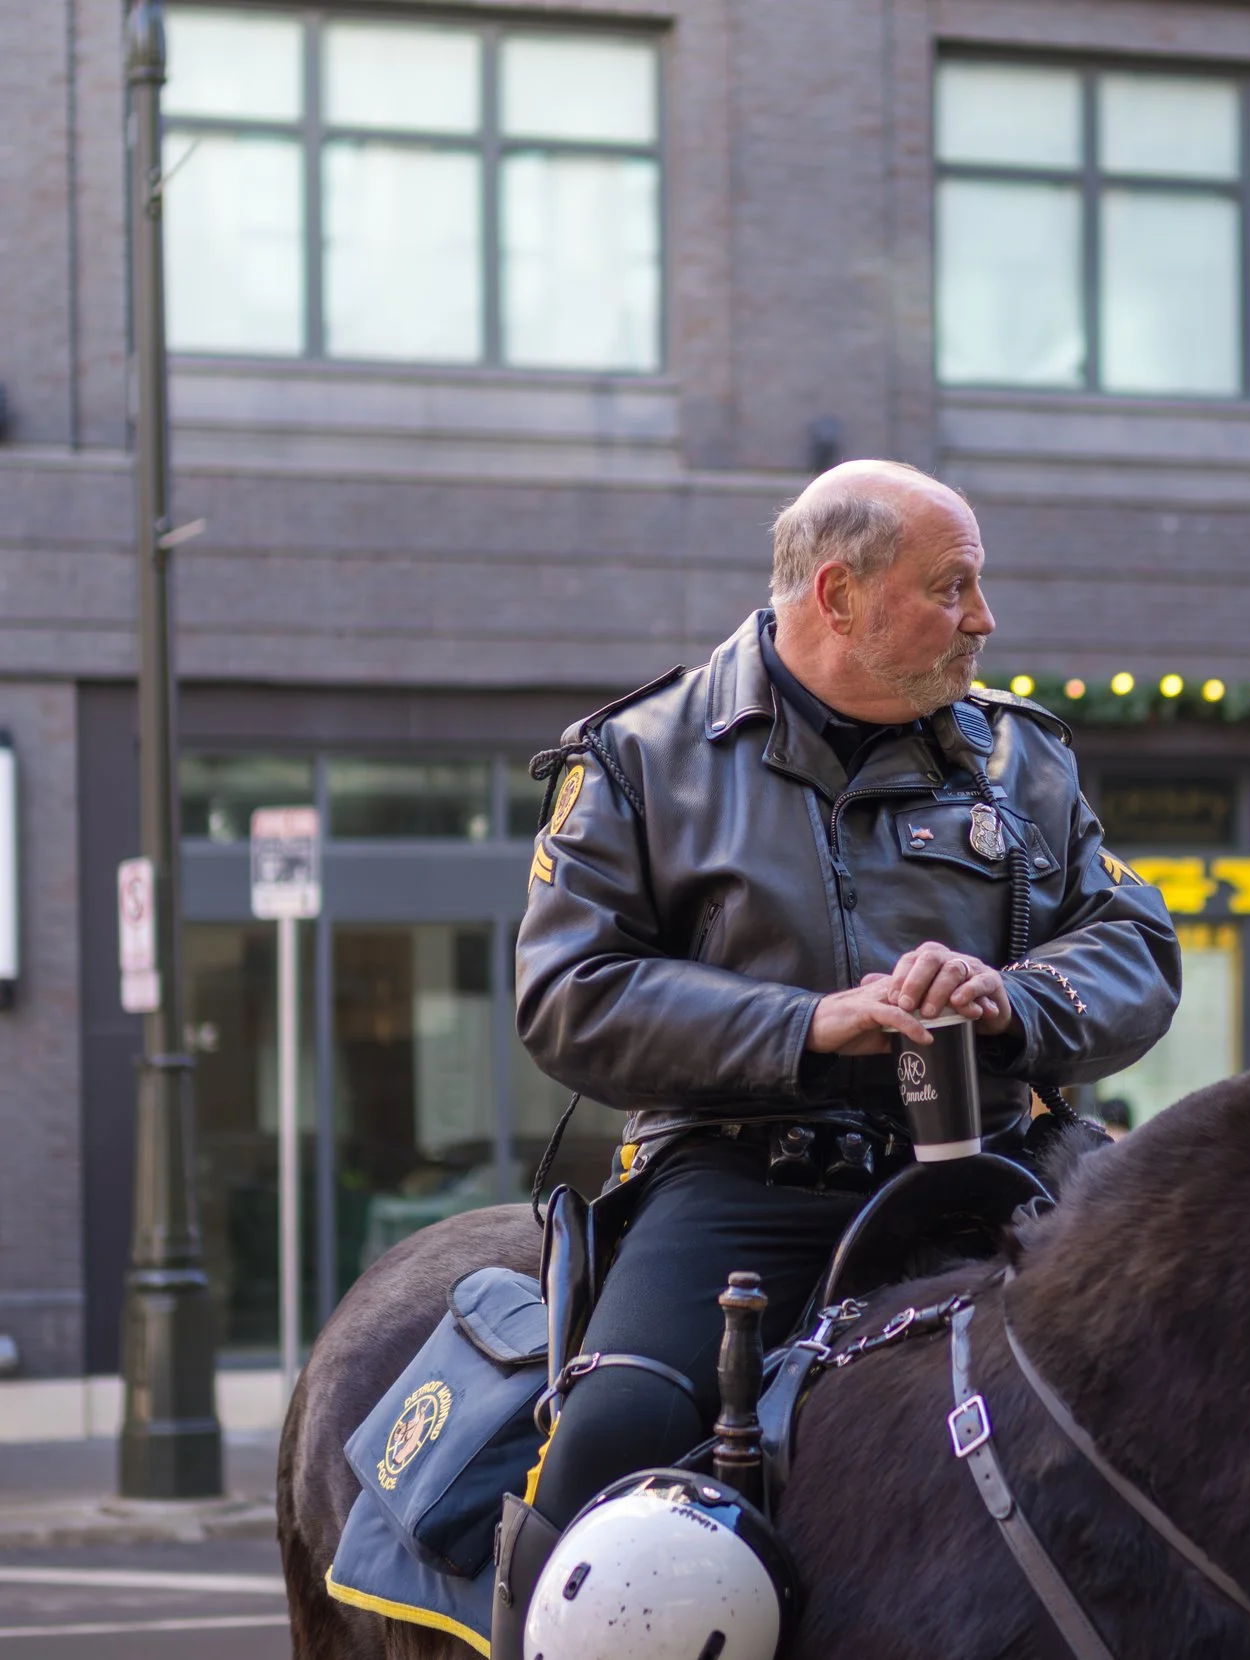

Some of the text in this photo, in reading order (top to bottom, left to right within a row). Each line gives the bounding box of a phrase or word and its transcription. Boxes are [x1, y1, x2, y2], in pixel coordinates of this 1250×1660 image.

[900, 1084, 938, 1106] Cannelle
[404, 1381, 453, 1441] DETROIT MOUNTED
[376, 1459, 398, 1490] POLICE
